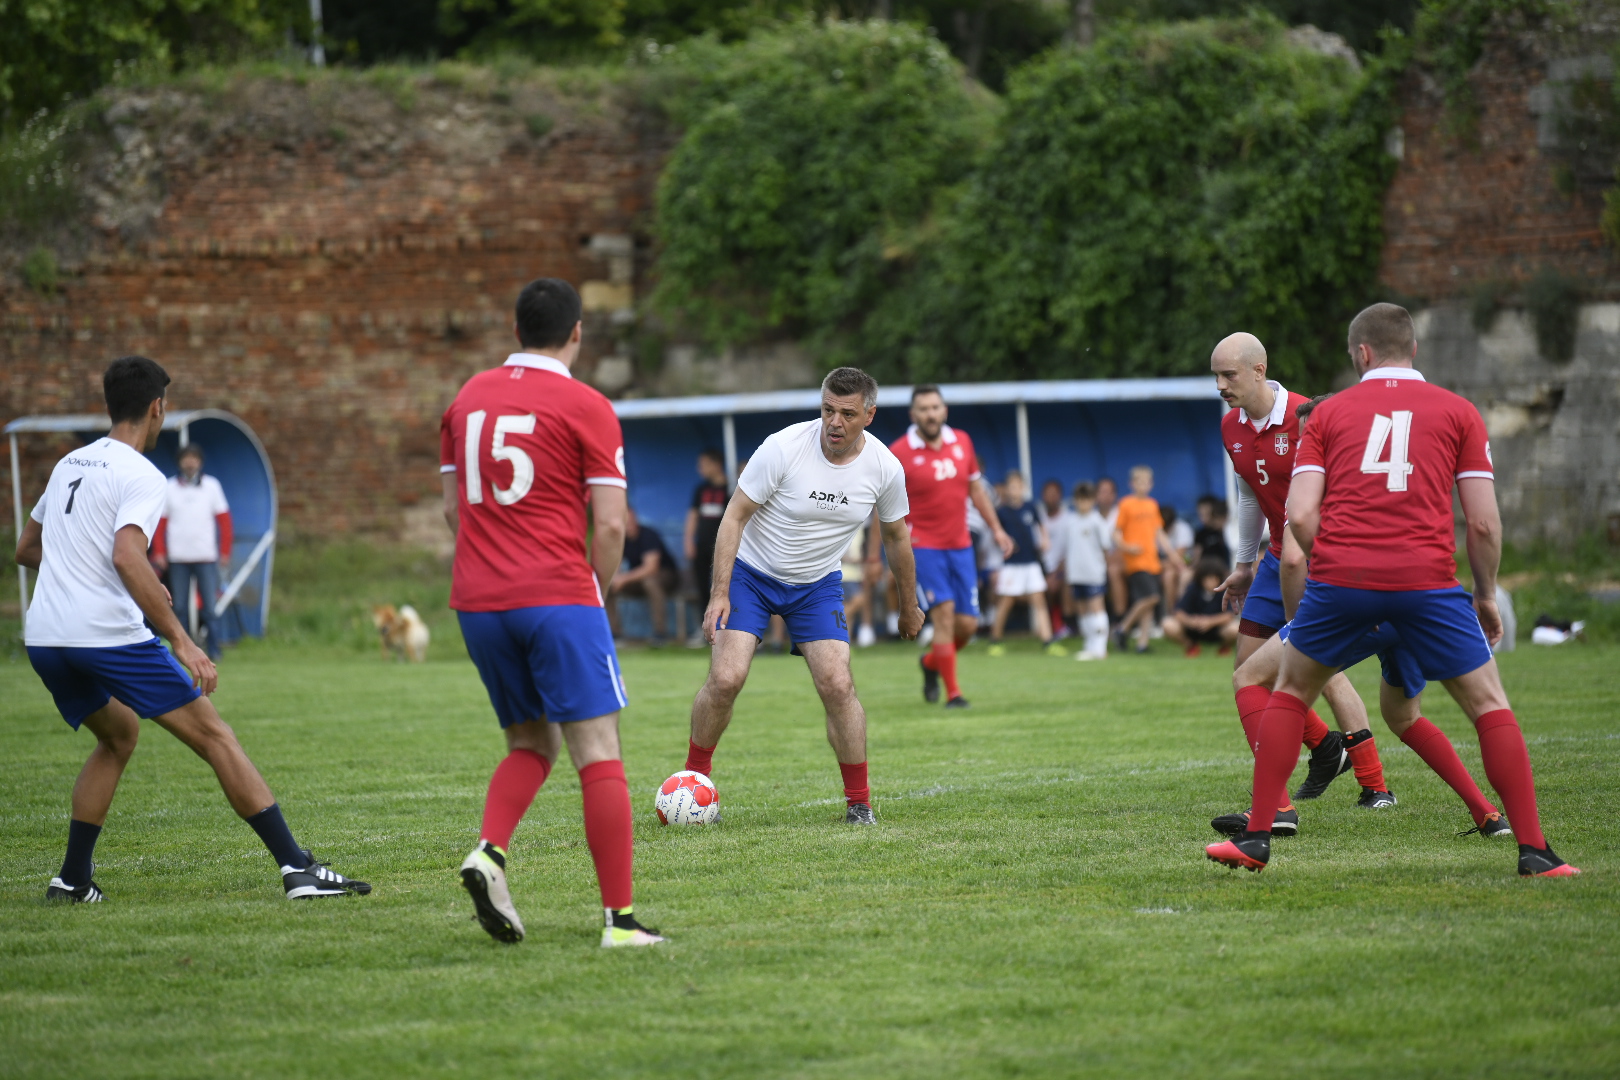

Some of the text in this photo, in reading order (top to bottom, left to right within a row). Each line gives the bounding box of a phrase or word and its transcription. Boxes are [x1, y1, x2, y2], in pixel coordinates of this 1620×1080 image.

[465, 409, 537, 506] 15
[1360, 410, 1414, 492] 4
[931, 457, 957, 482] 28
[1256, 459, 1270, 486] 5
[64, 476, 84, 515] 1
[815, 499, 838, 511] tour
